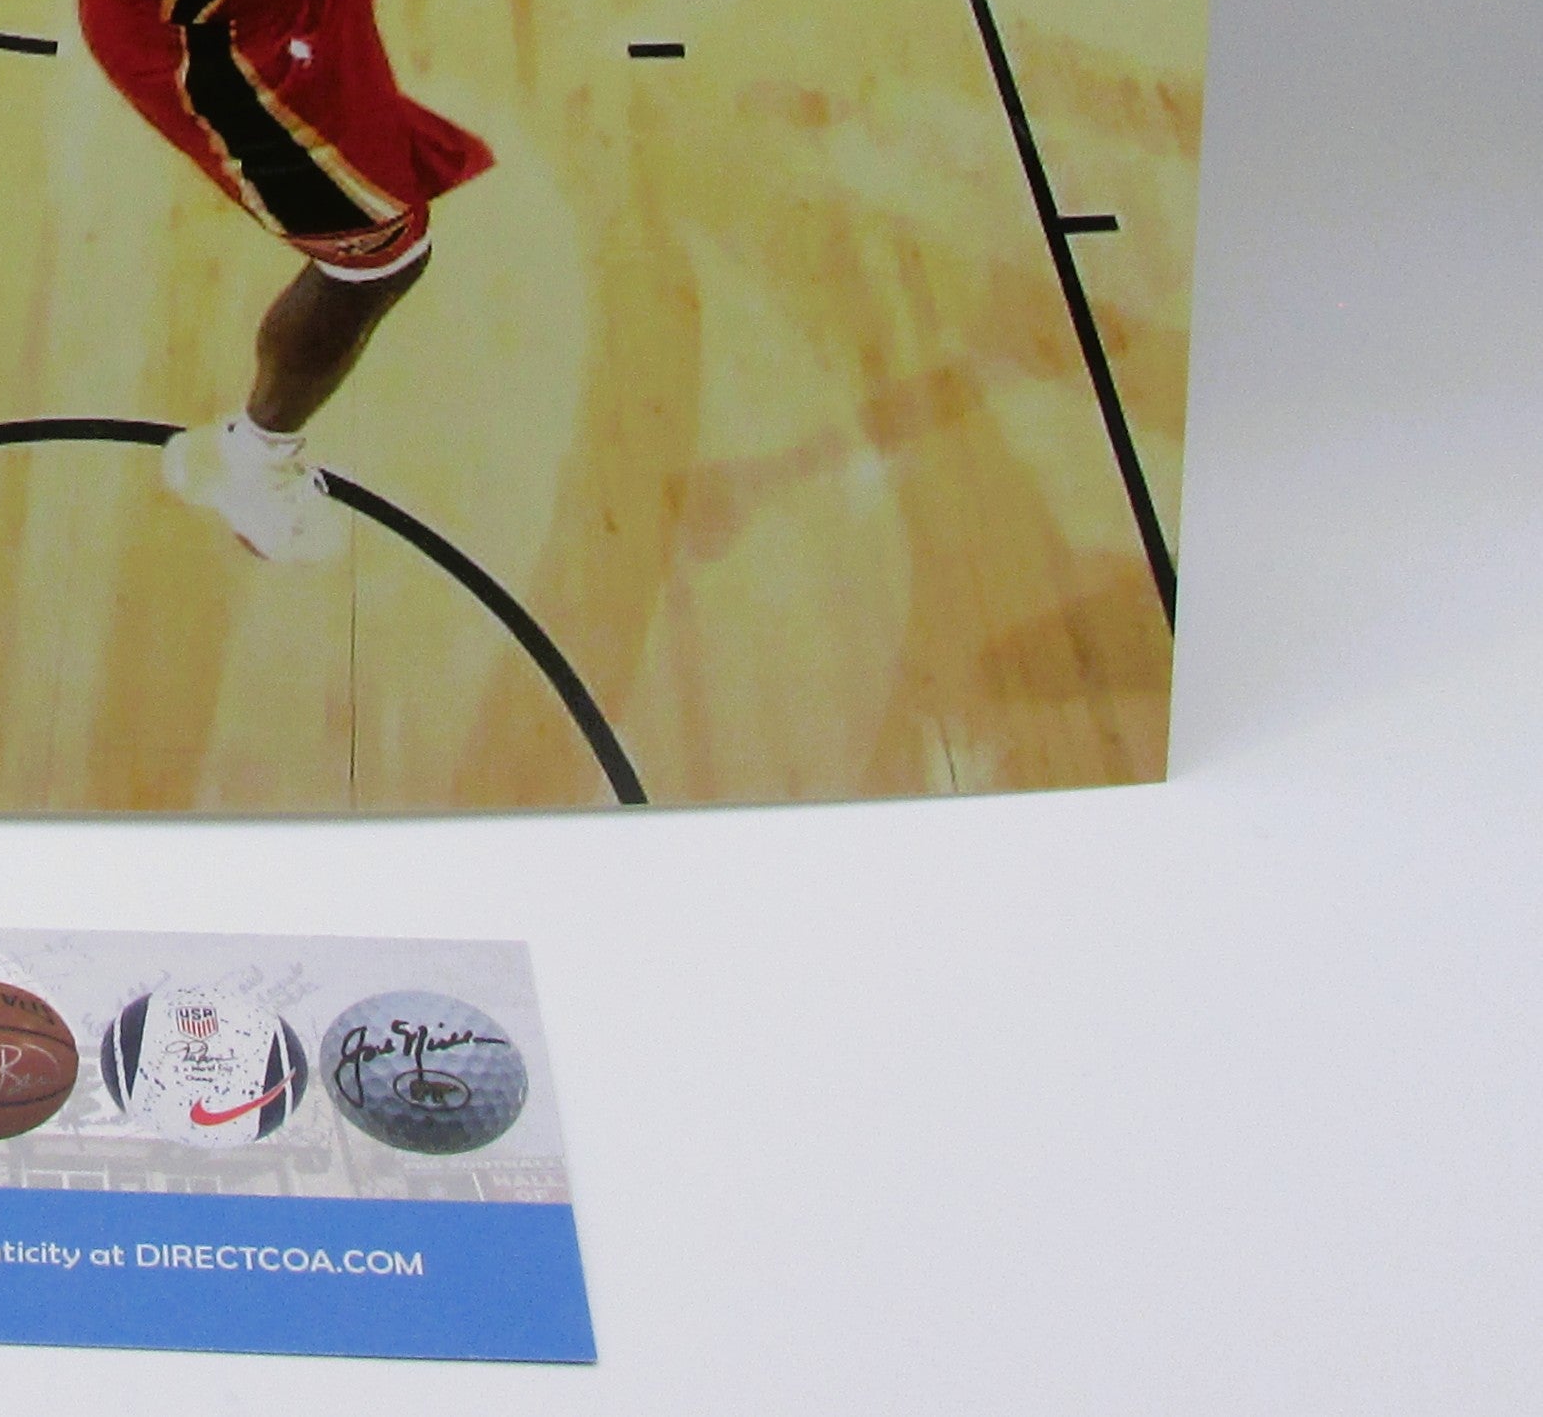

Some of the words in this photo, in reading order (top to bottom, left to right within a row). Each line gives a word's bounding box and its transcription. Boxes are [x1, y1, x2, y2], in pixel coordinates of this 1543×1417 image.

[179, 1008, 213, 1021] USA
[88, 1244, 127, 1267] at
[136, 1243, 424, 1276] DIRECTCOA.COM
